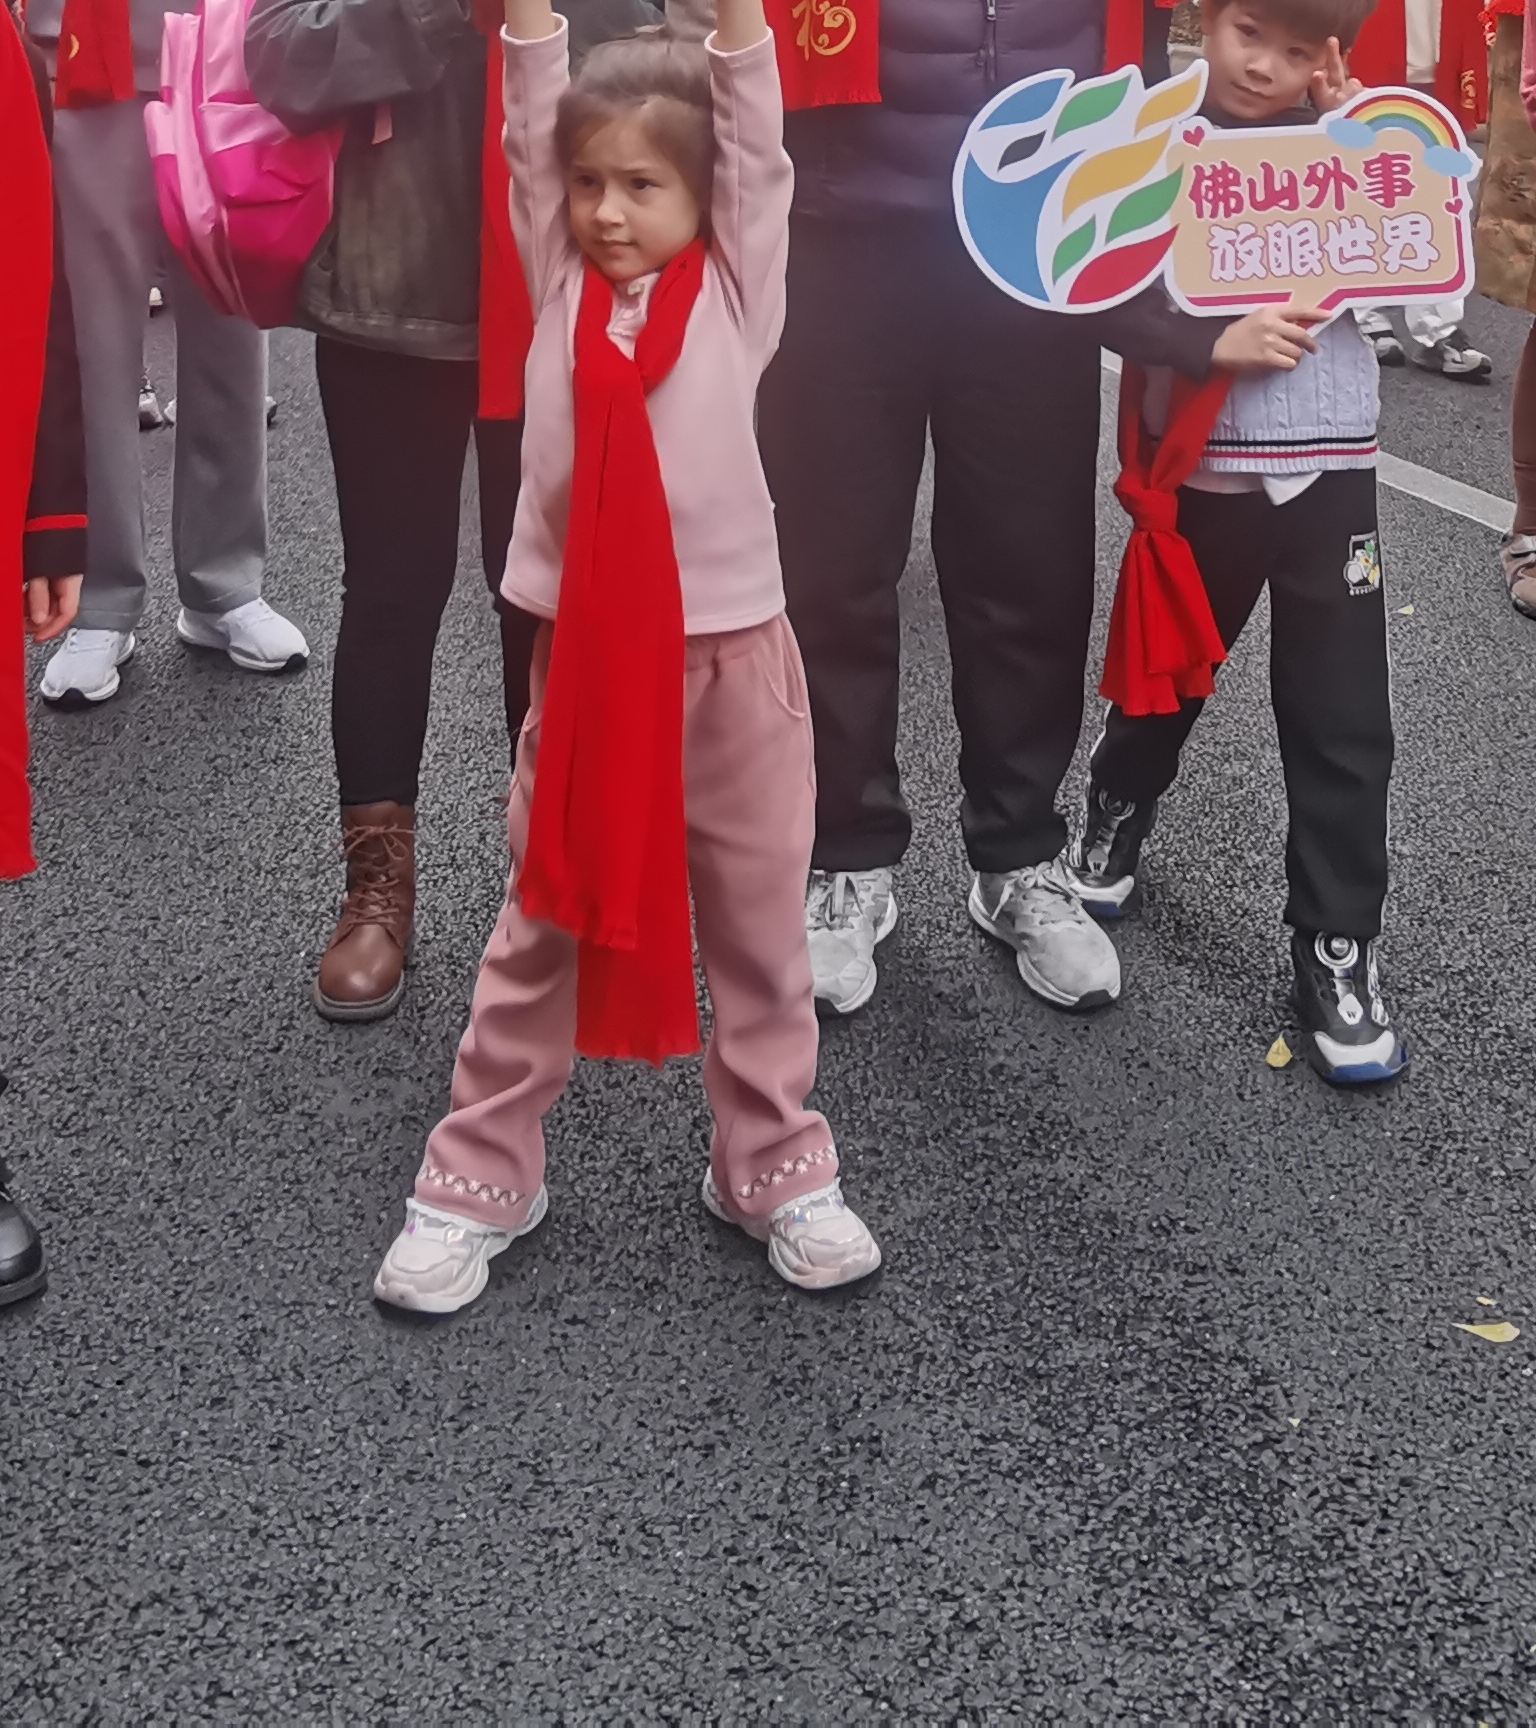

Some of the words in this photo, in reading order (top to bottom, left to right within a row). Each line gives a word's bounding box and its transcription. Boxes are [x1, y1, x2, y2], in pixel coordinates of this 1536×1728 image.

[1187, 152, 1417, 220] 佛山外事
[1207, 212, 1441, 284] 放眼世界
